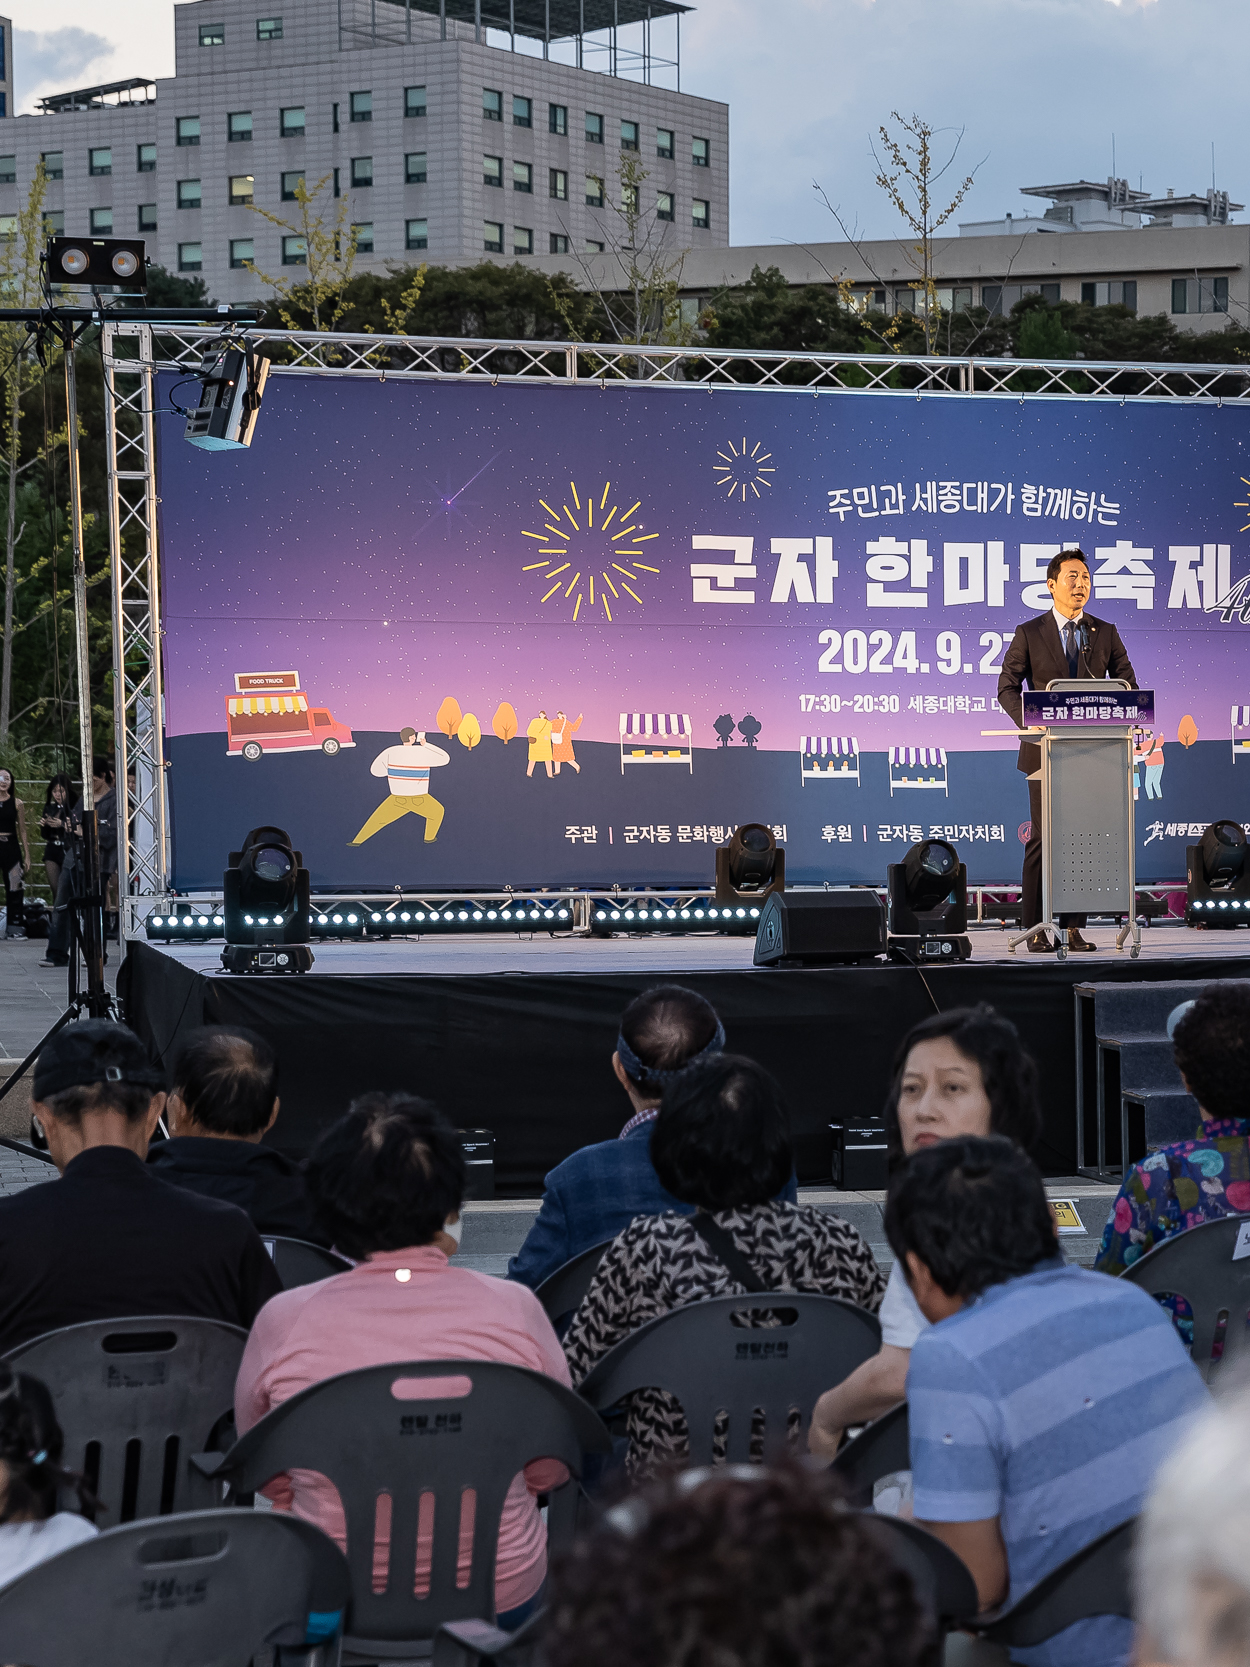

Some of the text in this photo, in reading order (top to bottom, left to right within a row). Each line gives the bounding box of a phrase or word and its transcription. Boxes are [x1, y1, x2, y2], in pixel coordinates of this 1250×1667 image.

[827, 481, 1120, 525] 주민과 세종대가 함께하는
[690, 535, 838, 604] 군자
[799, 694, 899, 713] 17:30~20:30
[907, 695, 987, 714] 세종대학교
[1042, 706, 1068, 720] 군자
[1072, 706, 1137, 720] 한마당축제
[564, 825, 598, 843] 주관
[623, 825, 672, 843] 군자동
[821, 824, 852, 842] 후원
[877, 824, 923, 843] 군자동
[928, 824, 1005, 842] 주민자치회
